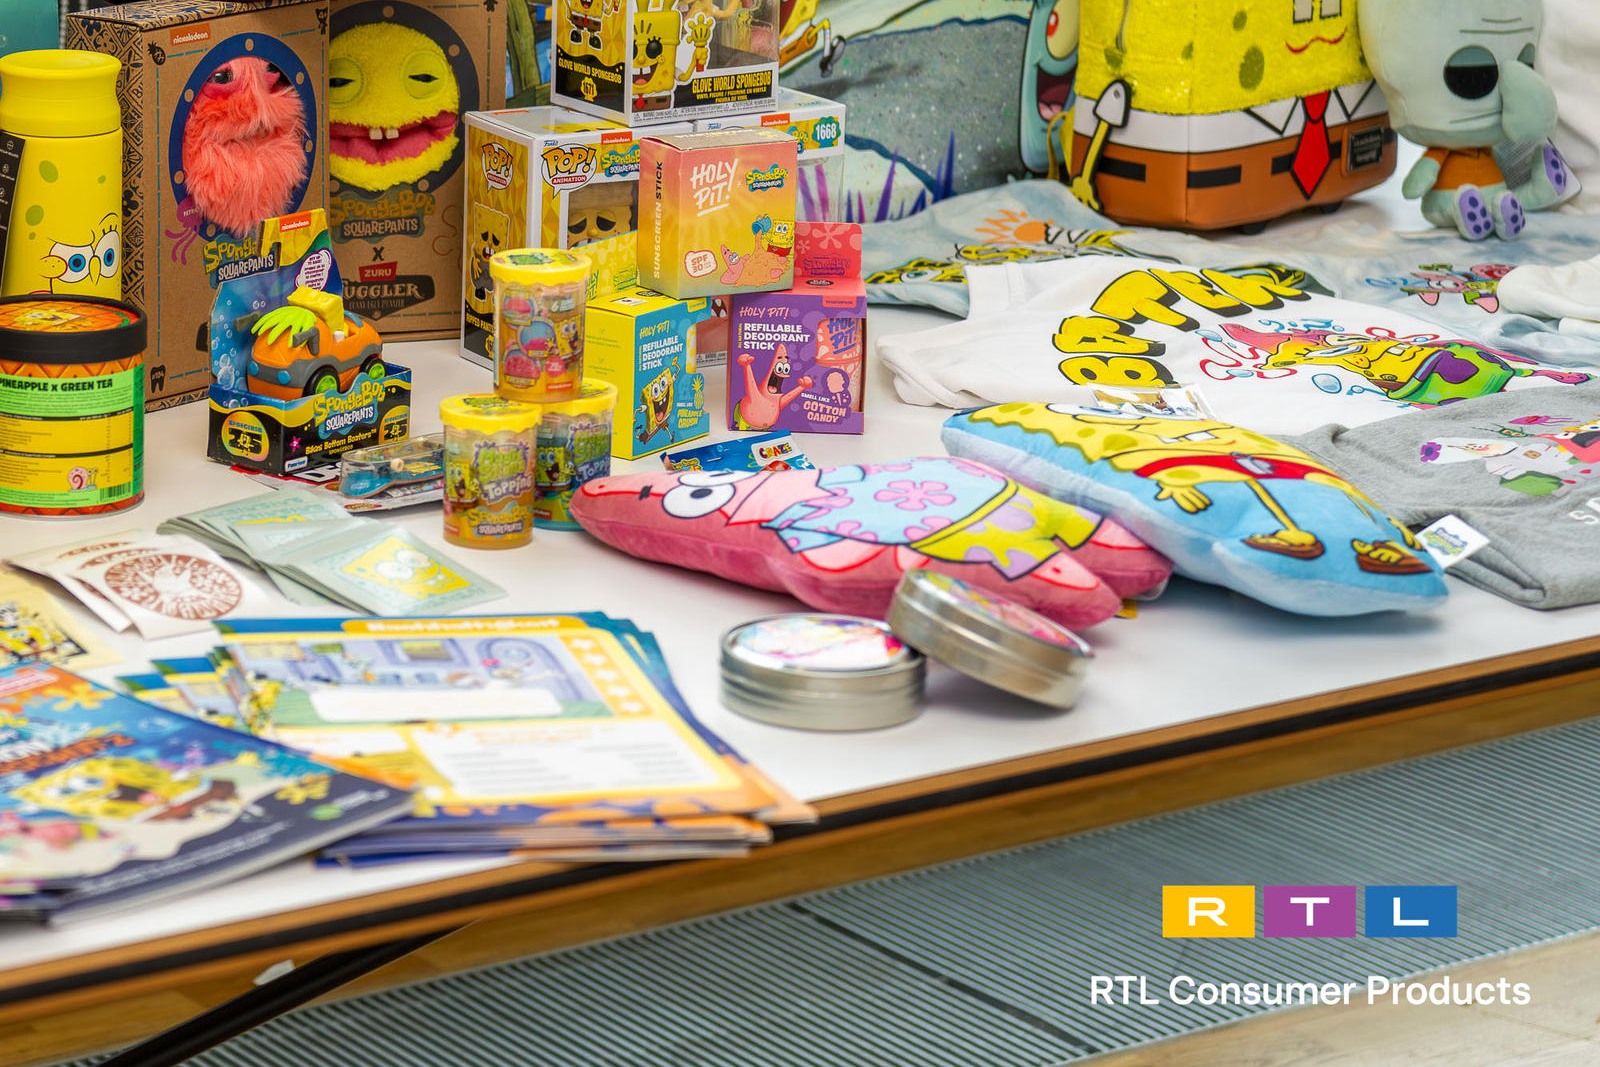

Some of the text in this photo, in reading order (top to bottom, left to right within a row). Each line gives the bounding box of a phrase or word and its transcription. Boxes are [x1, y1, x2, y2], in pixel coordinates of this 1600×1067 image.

[173, 31, 208, 45] nickelodeon
[558, 57, 623, 84] GLOVE WORLD SPONGEBOB
[692, 71, 772, 94] GLOVE WORLD SPONGEBOB
[814, 123, 837, 140] 1668
[603, 137, 631, 145] nickelodeon
[481, 144, 513, 177] POP!
[542, 146, 597, 178] POP!
[552, 175, 587, 184] ANIMATION
[690, 158, 739, 191] HOLY
[745, 166, 789, 186] SpongeBob
[281, 220, 310, 231] nickelodeon
[343, 218, 419, 235] SQUAREPANTS
[653, 161, 664, 279] SUNSCREEN STICK
[218, 253, 274, 281] SQUAREPANTS
[691, 256, 708, 265] SPF
[692, 263, 704, 272] 30
[363, 267, 392, 278] ZURU
[739, 306, 766, 318] HOLY
[640, 323, 655, 340] HOLY
[744, 323, 802, 333] REFILLABLE
[643, 335, 680, 353] REFILLABLE
[743, 342, 775, 351] STICK
[744, 333, 810, 343] DEODORANT
[643, 344, 684, 363] DEODORANT
[643, 360, 663, 371] STICK
[61, 379, 94, 392] GREEN
[96, 378, 113, 390] TEA
[313, 379, 386, 427] SpongeBob
[801, 392, 817, 400] SMELL
[803, 400, 847, 417] COTTON
[326, 406, 374, 432] SQUAREPANTS
[807, 411, 840, 424] CANDY
[323, 437, 347, 452] Bottom
[758, 441, 793, 459] CRAZE
